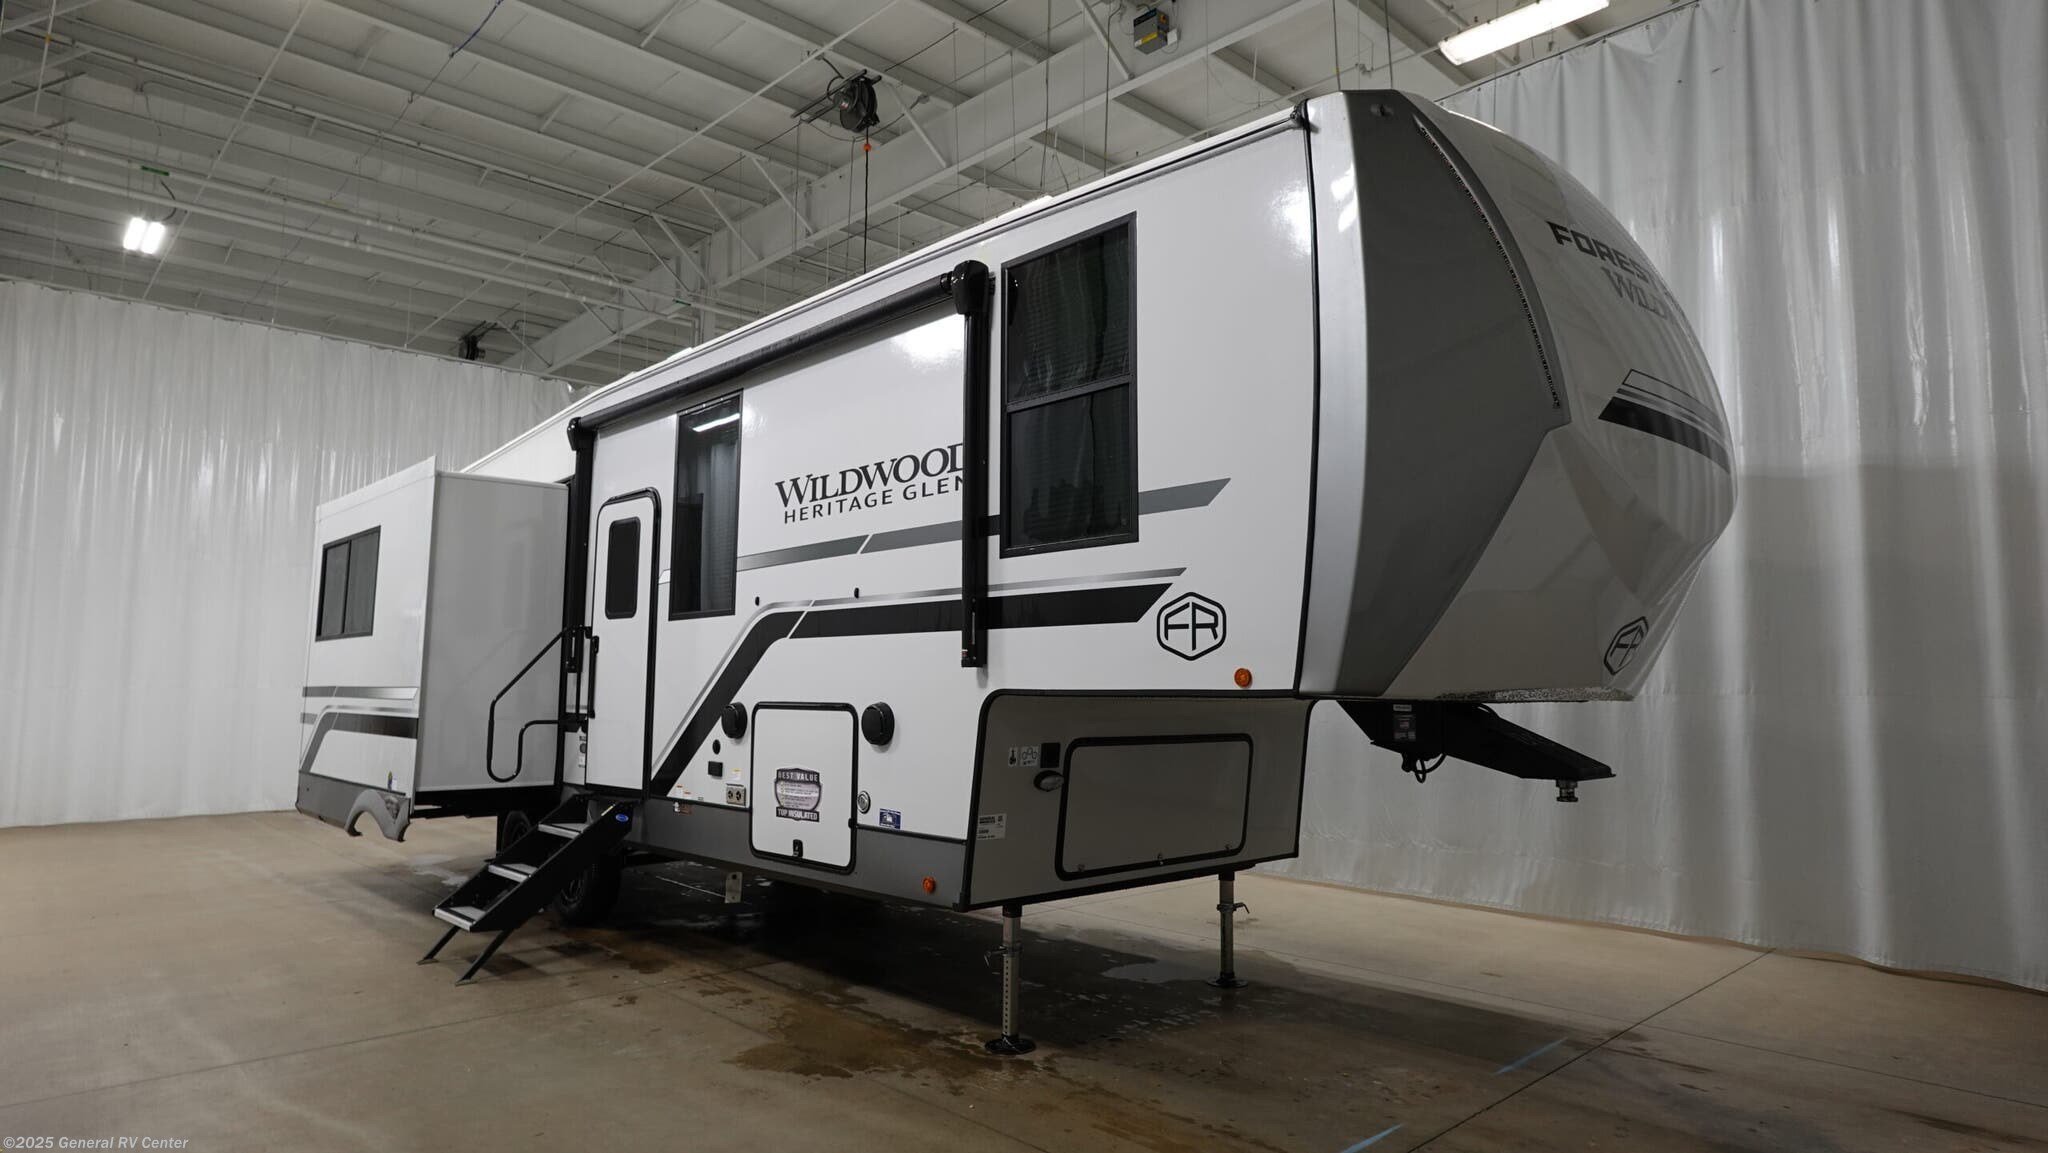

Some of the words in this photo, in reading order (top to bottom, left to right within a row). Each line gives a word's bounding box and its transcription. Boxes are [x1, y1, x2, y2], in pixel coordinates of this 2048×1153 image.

[784, 489, 893, 524] HERITAGE
[778, 770, 794, 780] BEST
[796, 772, 818, 782] VALUE
[777, 808, 788, 817] TOP
